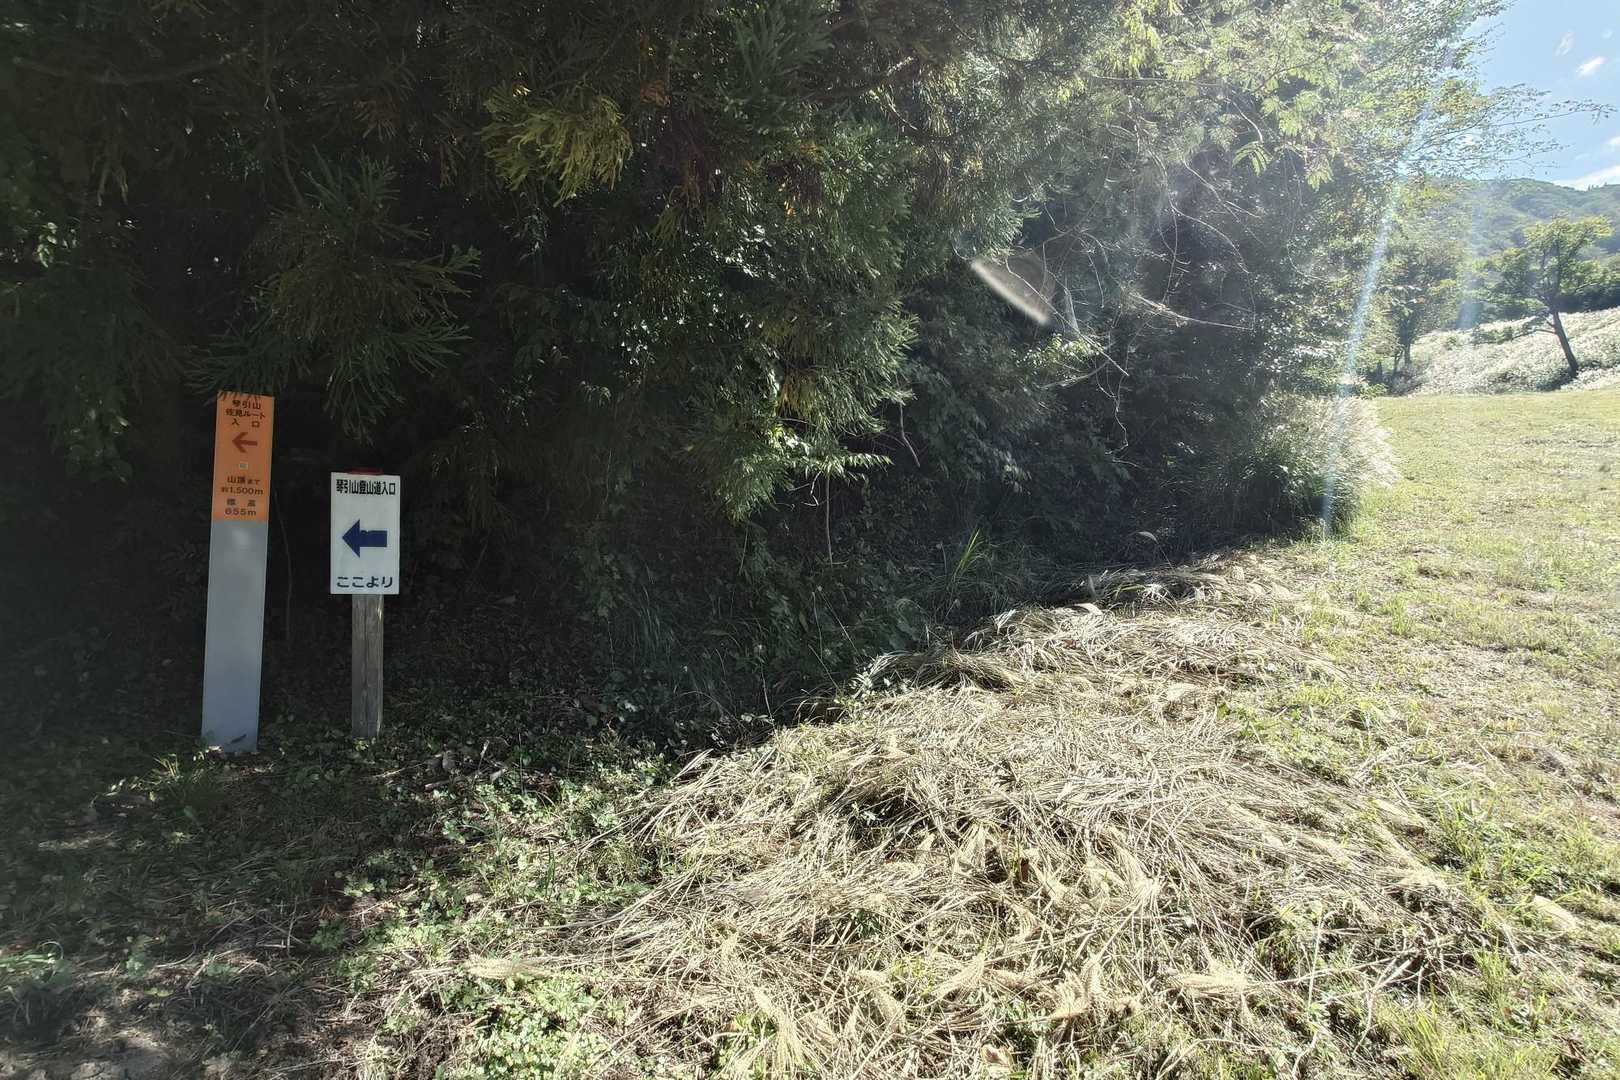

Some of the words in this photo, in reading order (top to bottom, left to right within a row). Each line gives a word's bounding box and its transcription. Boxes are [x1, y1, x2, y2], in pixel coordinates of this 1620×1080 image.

[335, 478, 396, 496] 琴引山登山道入口
[336, 575, 394, 589] ここより
